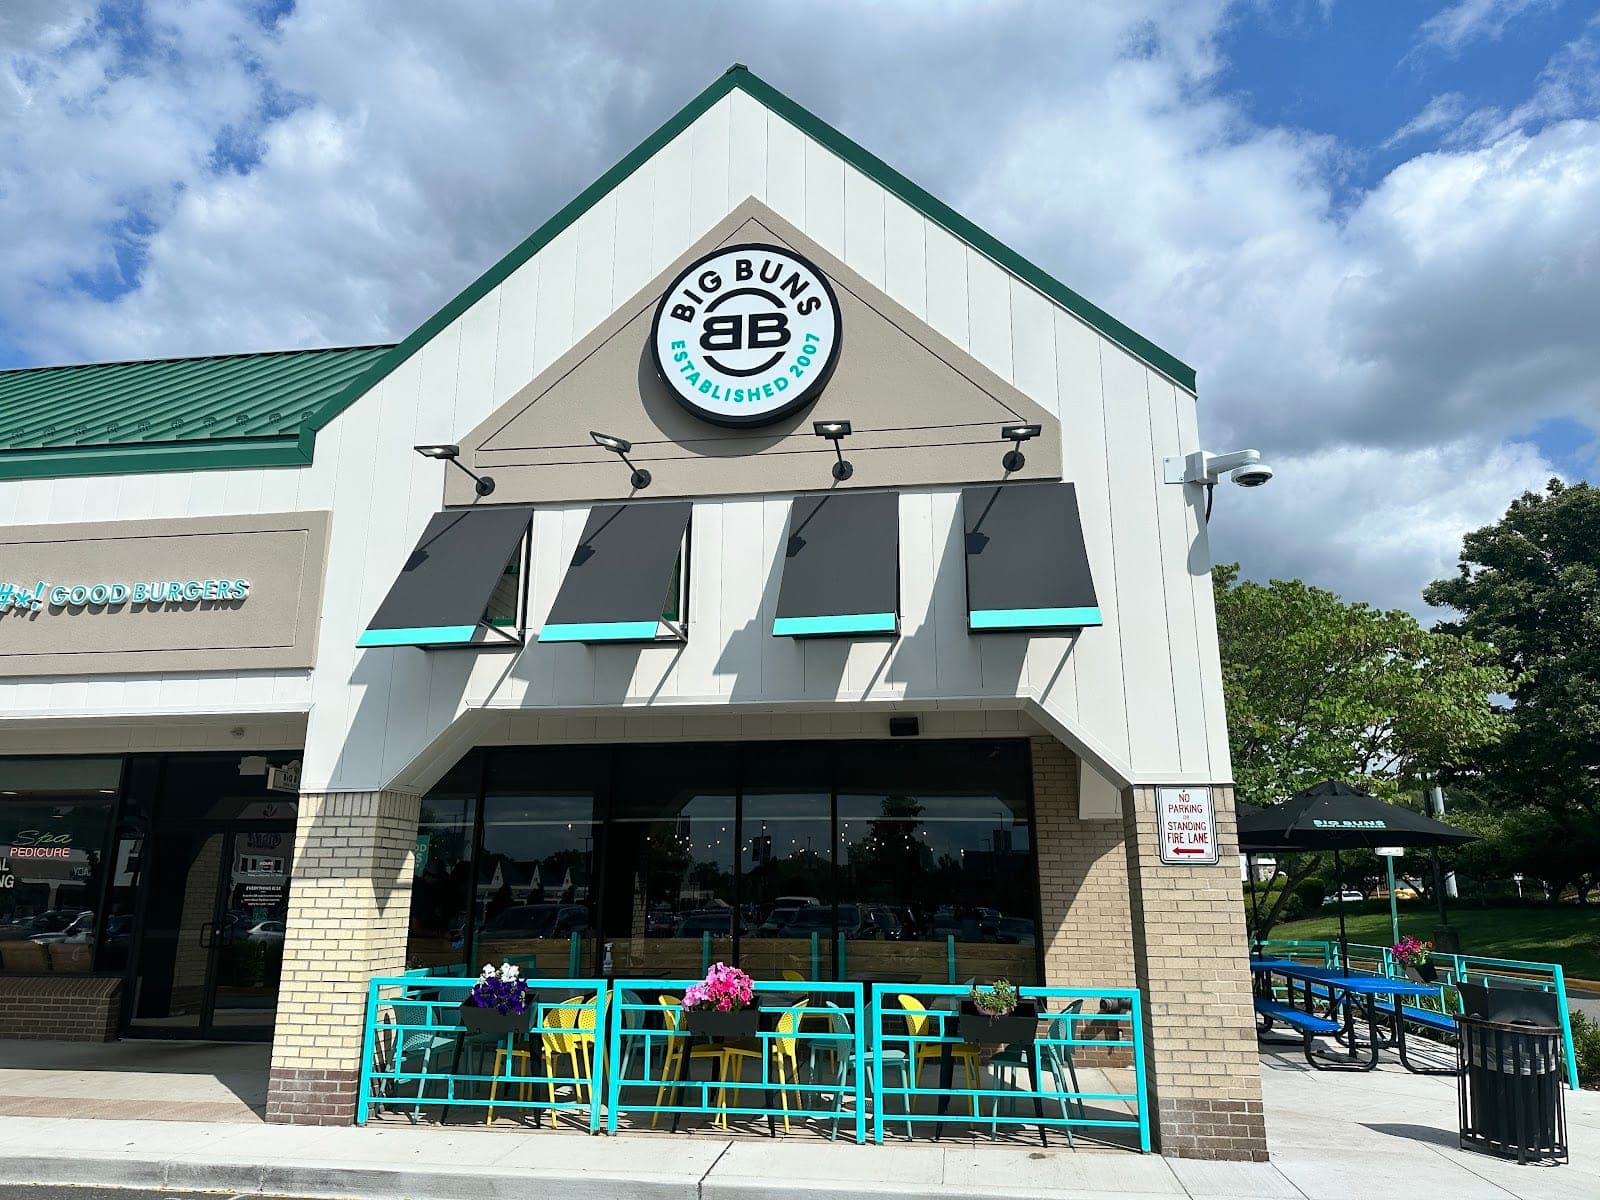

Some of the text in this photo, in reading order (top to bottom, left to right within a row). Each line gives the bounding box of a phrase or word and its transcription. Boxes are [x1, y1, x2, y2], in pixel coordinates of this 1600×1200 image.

[670, 259, 822, 323] BIG BUNS
[671, 333, 820, 402] ESTABLISHED 2007
[50, 583, 128, 606] GOOD
[132, 579, 249, 604] BURGERS
[1178, 793, 1190, 803] NO
[1168, 804, 1203, 814] PARKING
[1167, 821, 1207, 831] STANDING
[1313, 819, 1340, 828] BIG
[1343, 820, 1386, 828] BUNS
[12, 829, 73, 846] Spa
[1167, 832, 1209, 844] FIRE LANE
[9, 847, 71, 857] PEDICURE
[0, 857, 10, 871] L
